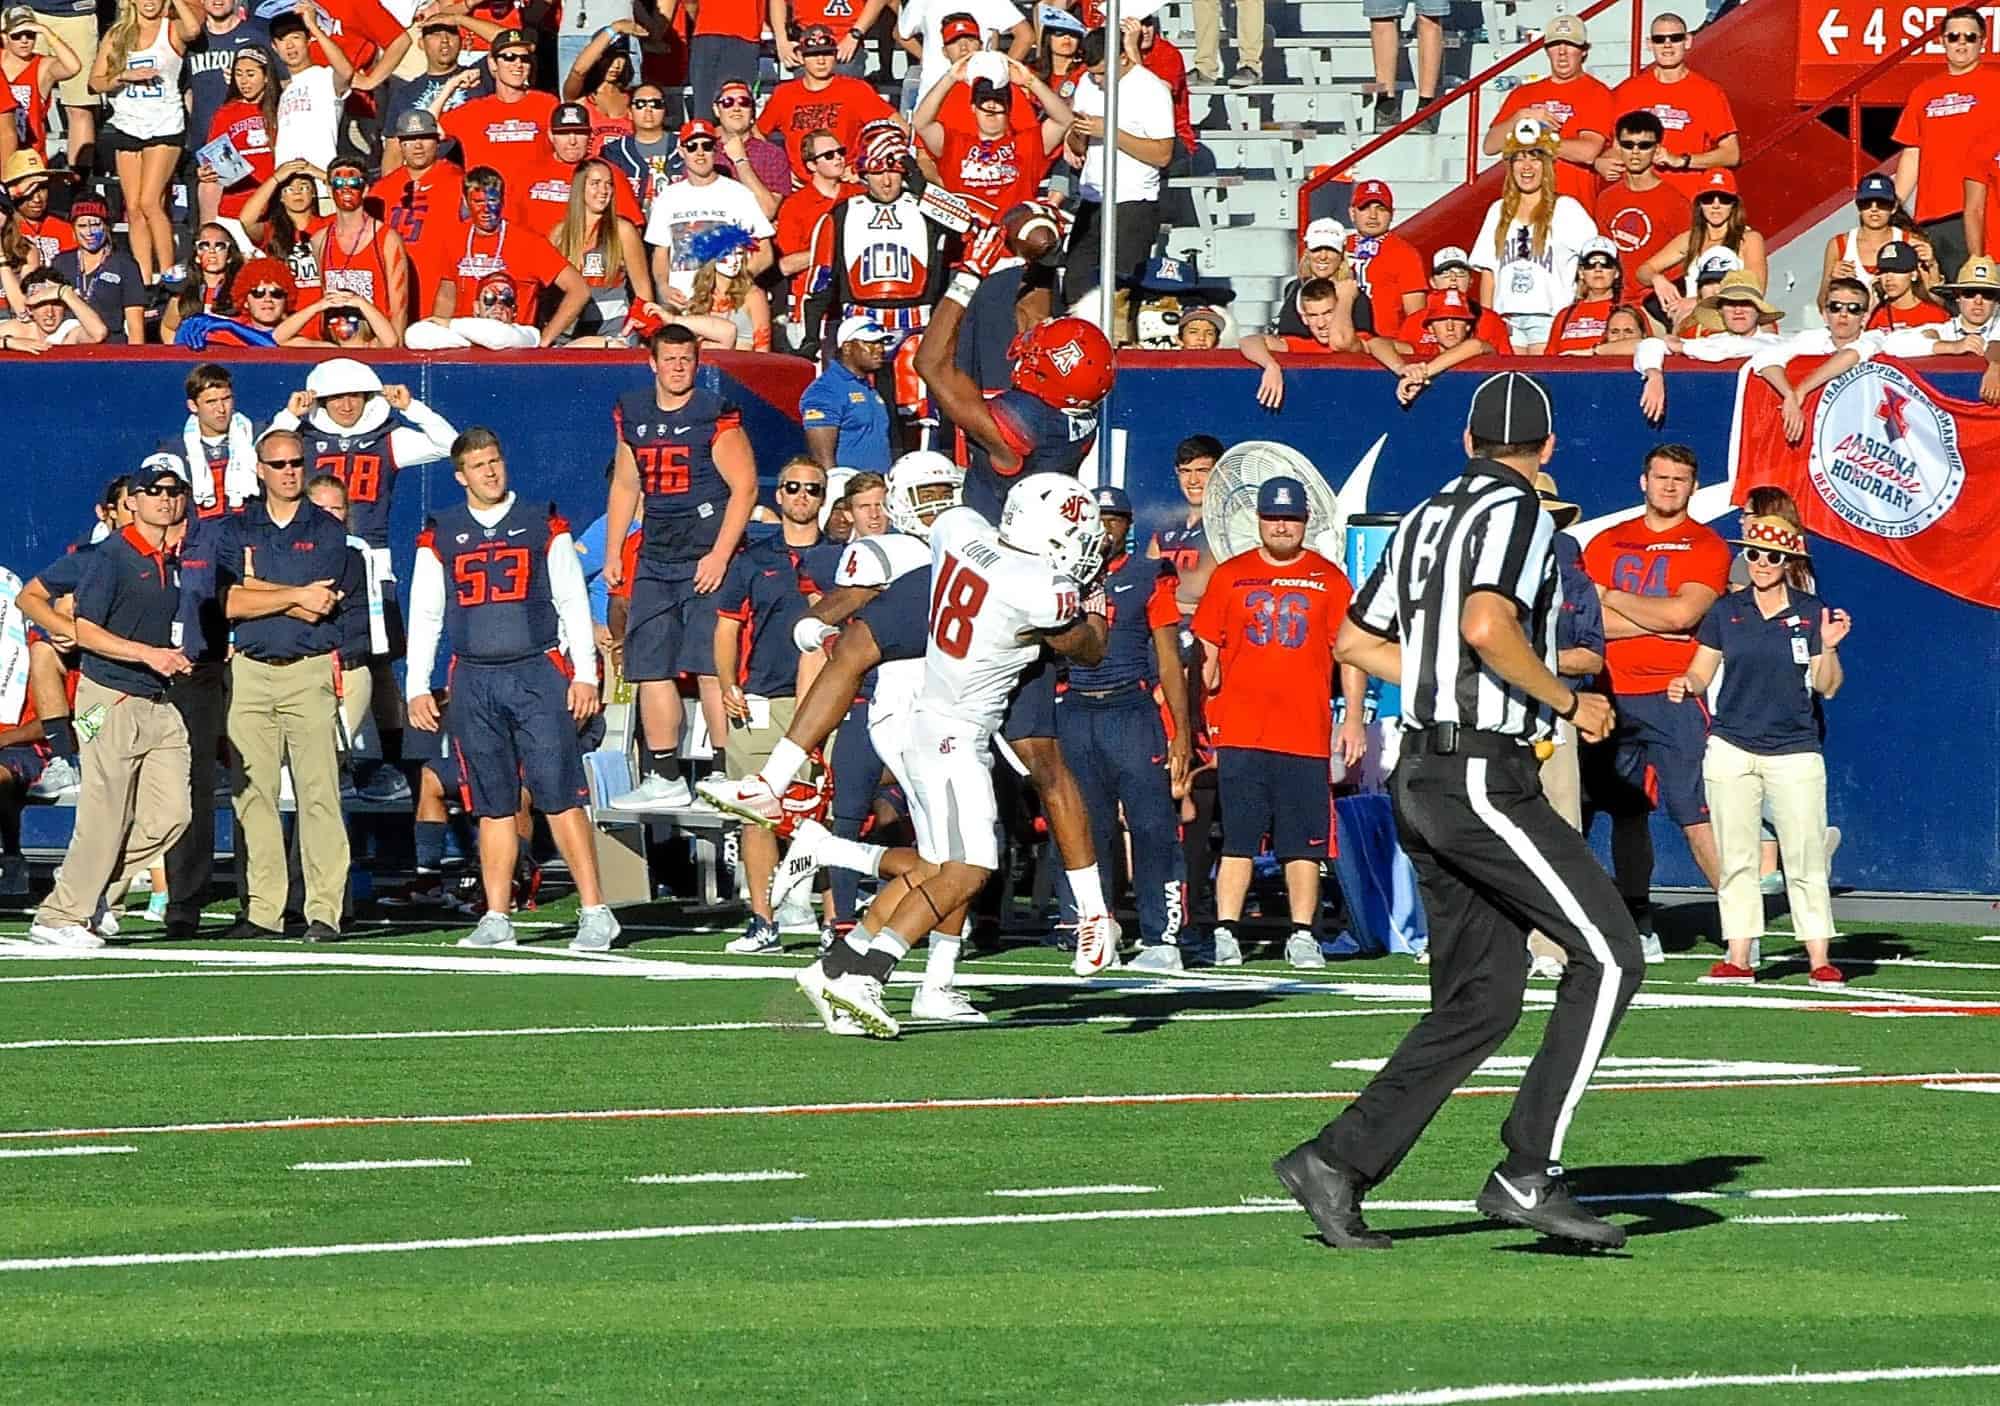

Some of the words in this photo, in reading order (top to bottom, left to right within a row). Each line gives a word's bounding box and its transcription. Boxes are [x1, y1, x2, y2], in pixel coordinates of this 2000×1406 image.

[1863, 7, 1887, 55] 4
[191, 50, 234, 76] ARIZO
[867, 204, 903, 230] A
[1850, 433, 1917, 479] ARIZONA
[1830, 459, 1914, 512] HONORARY
[454, 547, 532, 608] 53
[845, 550, 857, 578] 4
[961, 539, 1001, 570] LUANI
[1612, 553, 1671, 599] 64
[929, 550, 990, 661] 18
[1271, 578, 1328, 592] FOOTBALL
[1244, 589, 1312, 649] 36
[789, 855, 813, 876] NIKE
